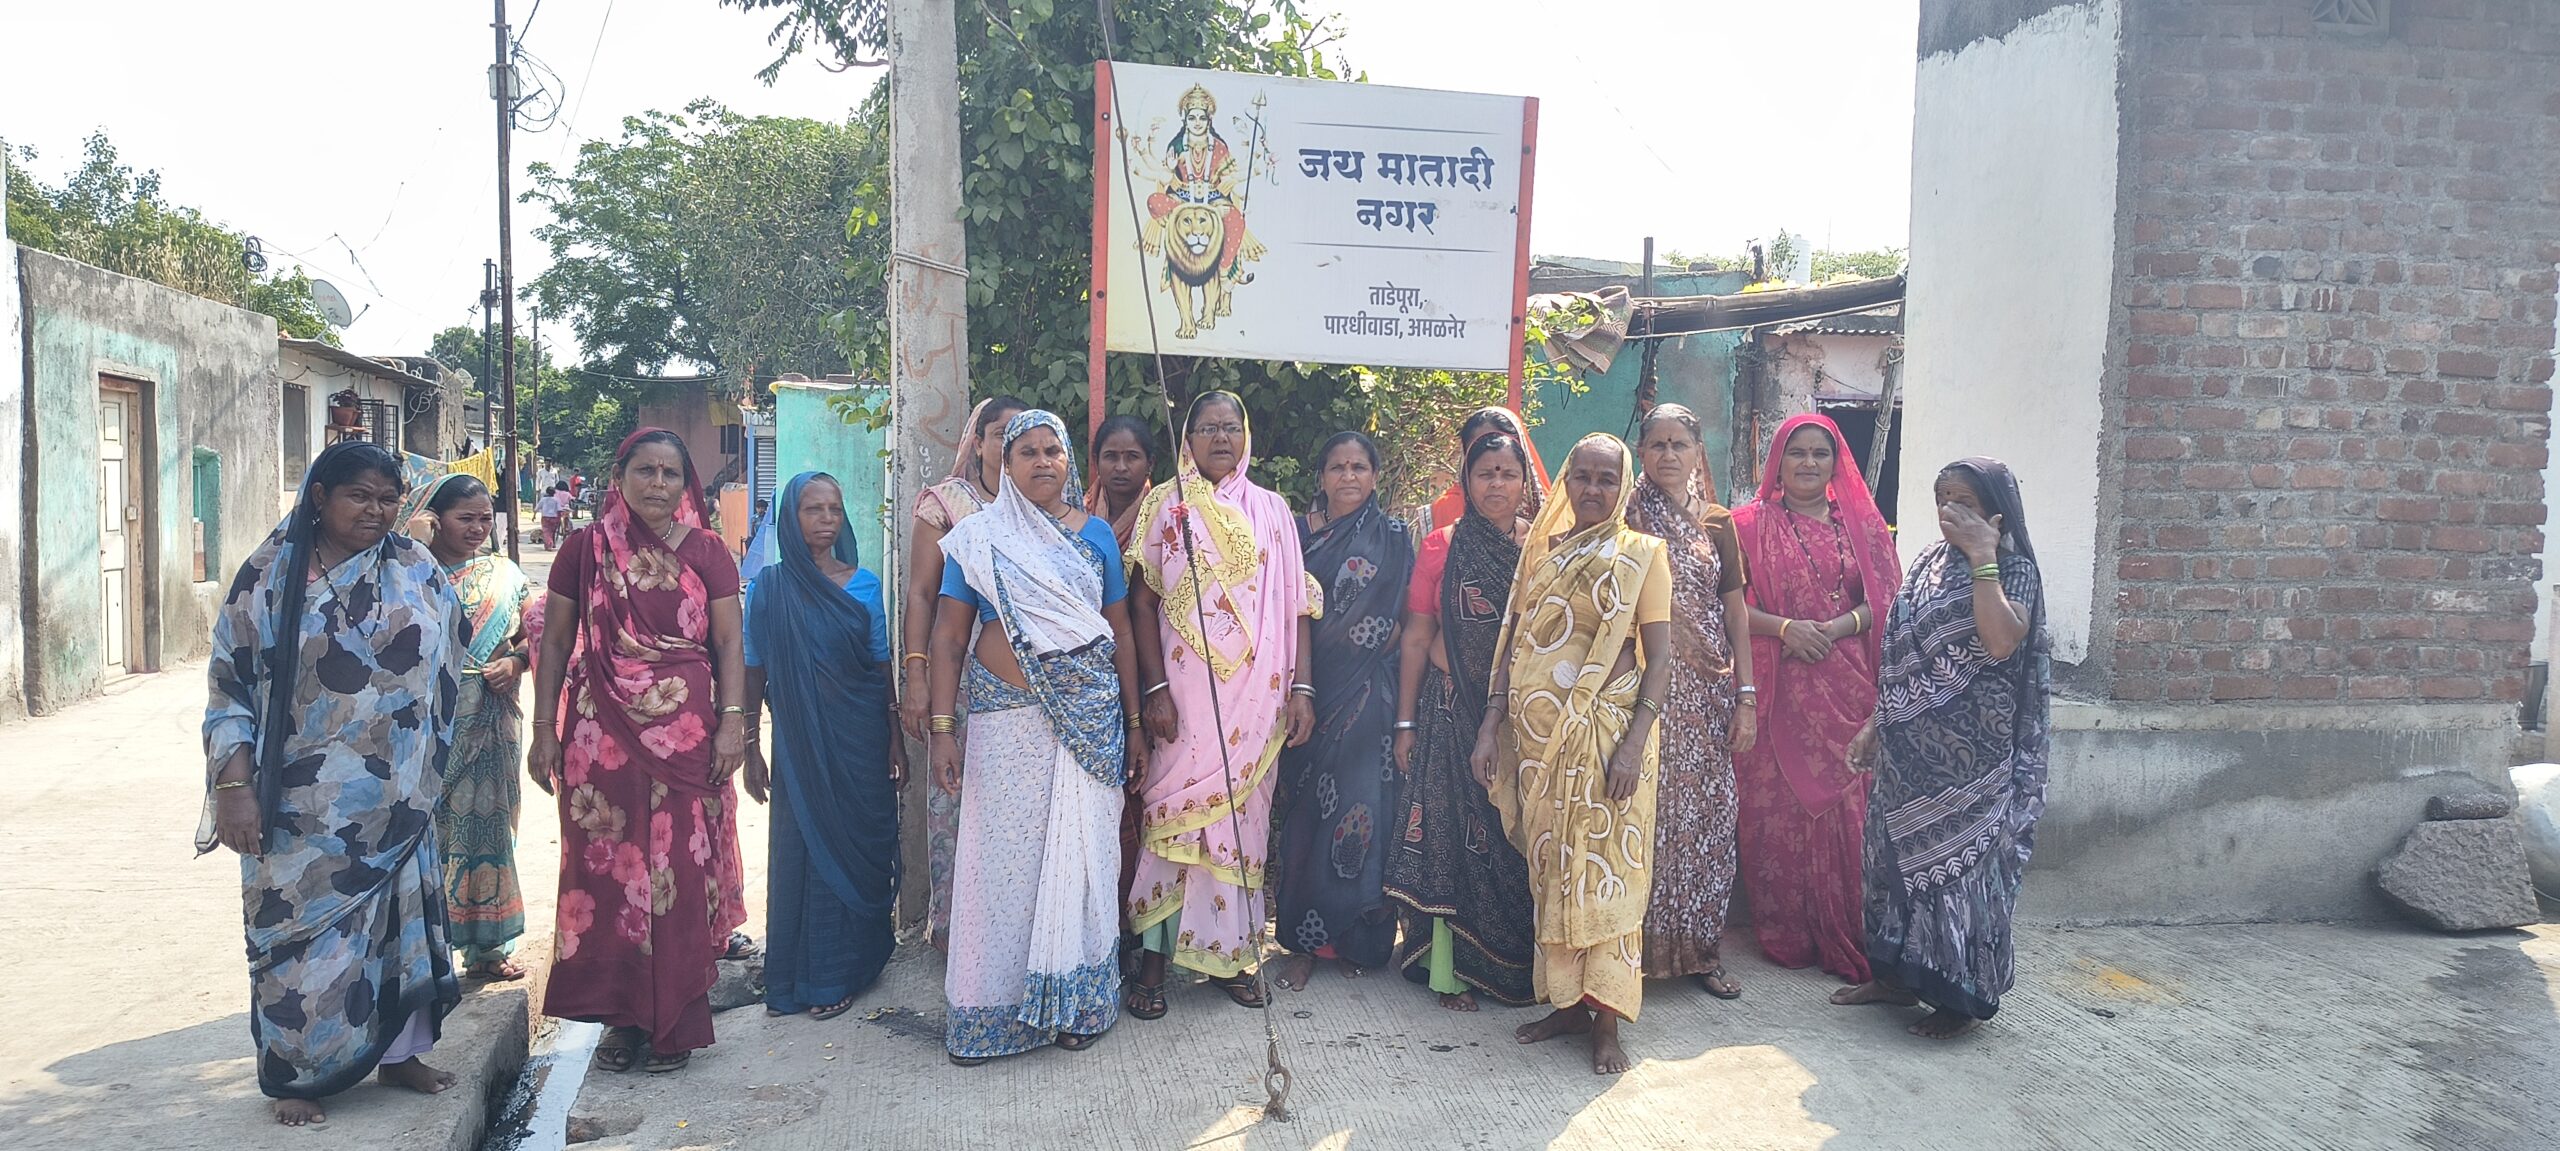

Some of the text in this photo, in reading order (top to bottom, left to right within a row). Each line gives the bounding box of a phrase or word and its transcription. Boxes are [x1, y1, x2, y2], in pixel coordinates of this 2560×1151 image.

[1299, 146, 1495, 192] जय मातादी
[1356, 199, 1437, 235] नगर
[1323, 310, 1467, 339] पारधीवाडा, अमळनेर
